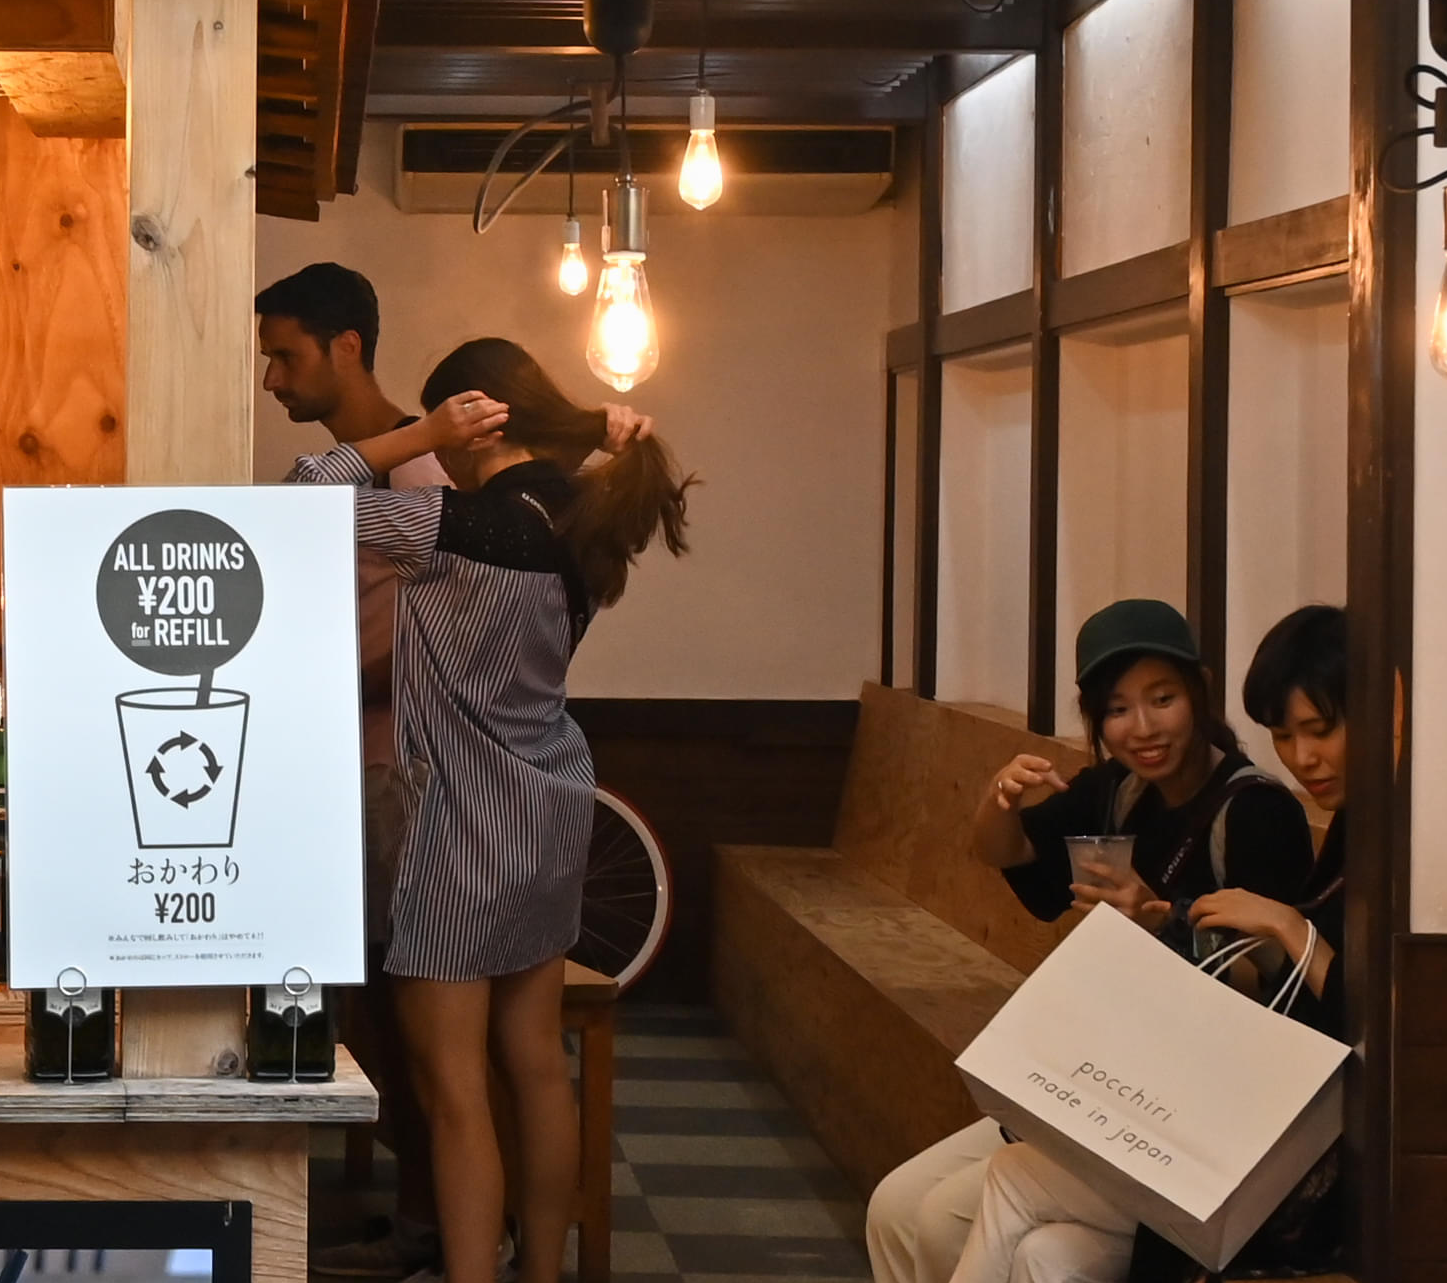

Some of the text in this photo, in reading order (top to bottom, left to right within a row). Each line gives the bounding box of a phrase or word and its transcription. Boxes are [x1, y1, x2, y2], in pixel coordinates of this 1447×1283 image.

[114, 542, 245, 571] ALL DRINKS
[137, 575, 215, 616] ¥200
[131, 618, 230, 647] for REFILL
[126, 854, 242, 886] おかわり
[154, 892, 216, 924] ¥200
[1071, 1061, 1178, 1122] pocchiri
[1027, 1071, 1173, 1166] made in japan
